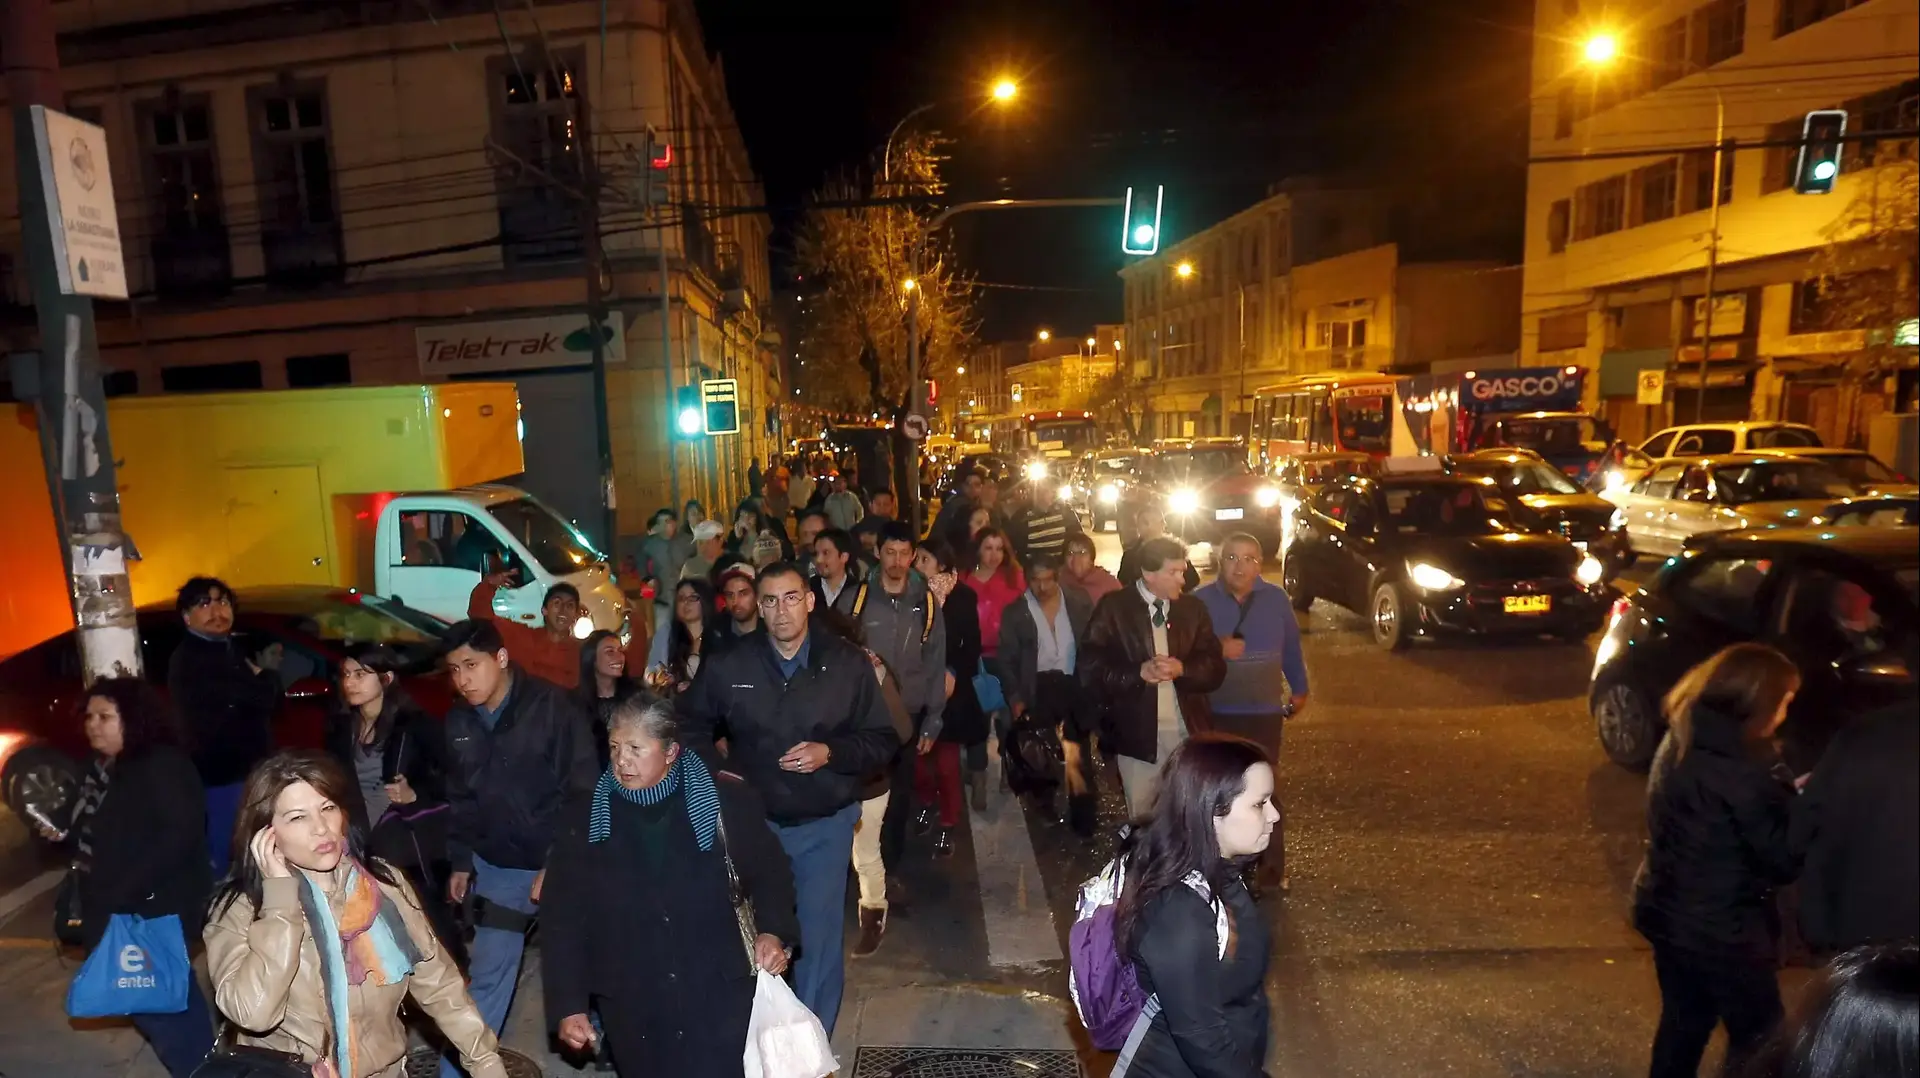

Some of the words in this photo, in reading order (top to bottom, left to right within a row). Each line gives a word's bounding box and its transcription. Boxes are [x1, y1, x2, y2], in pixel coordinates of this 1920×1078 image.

[424, 332, 561, 363] Teletrak
[1472, 376, 1559, 400] GASCO
[117, 975, 156, 988] entel
